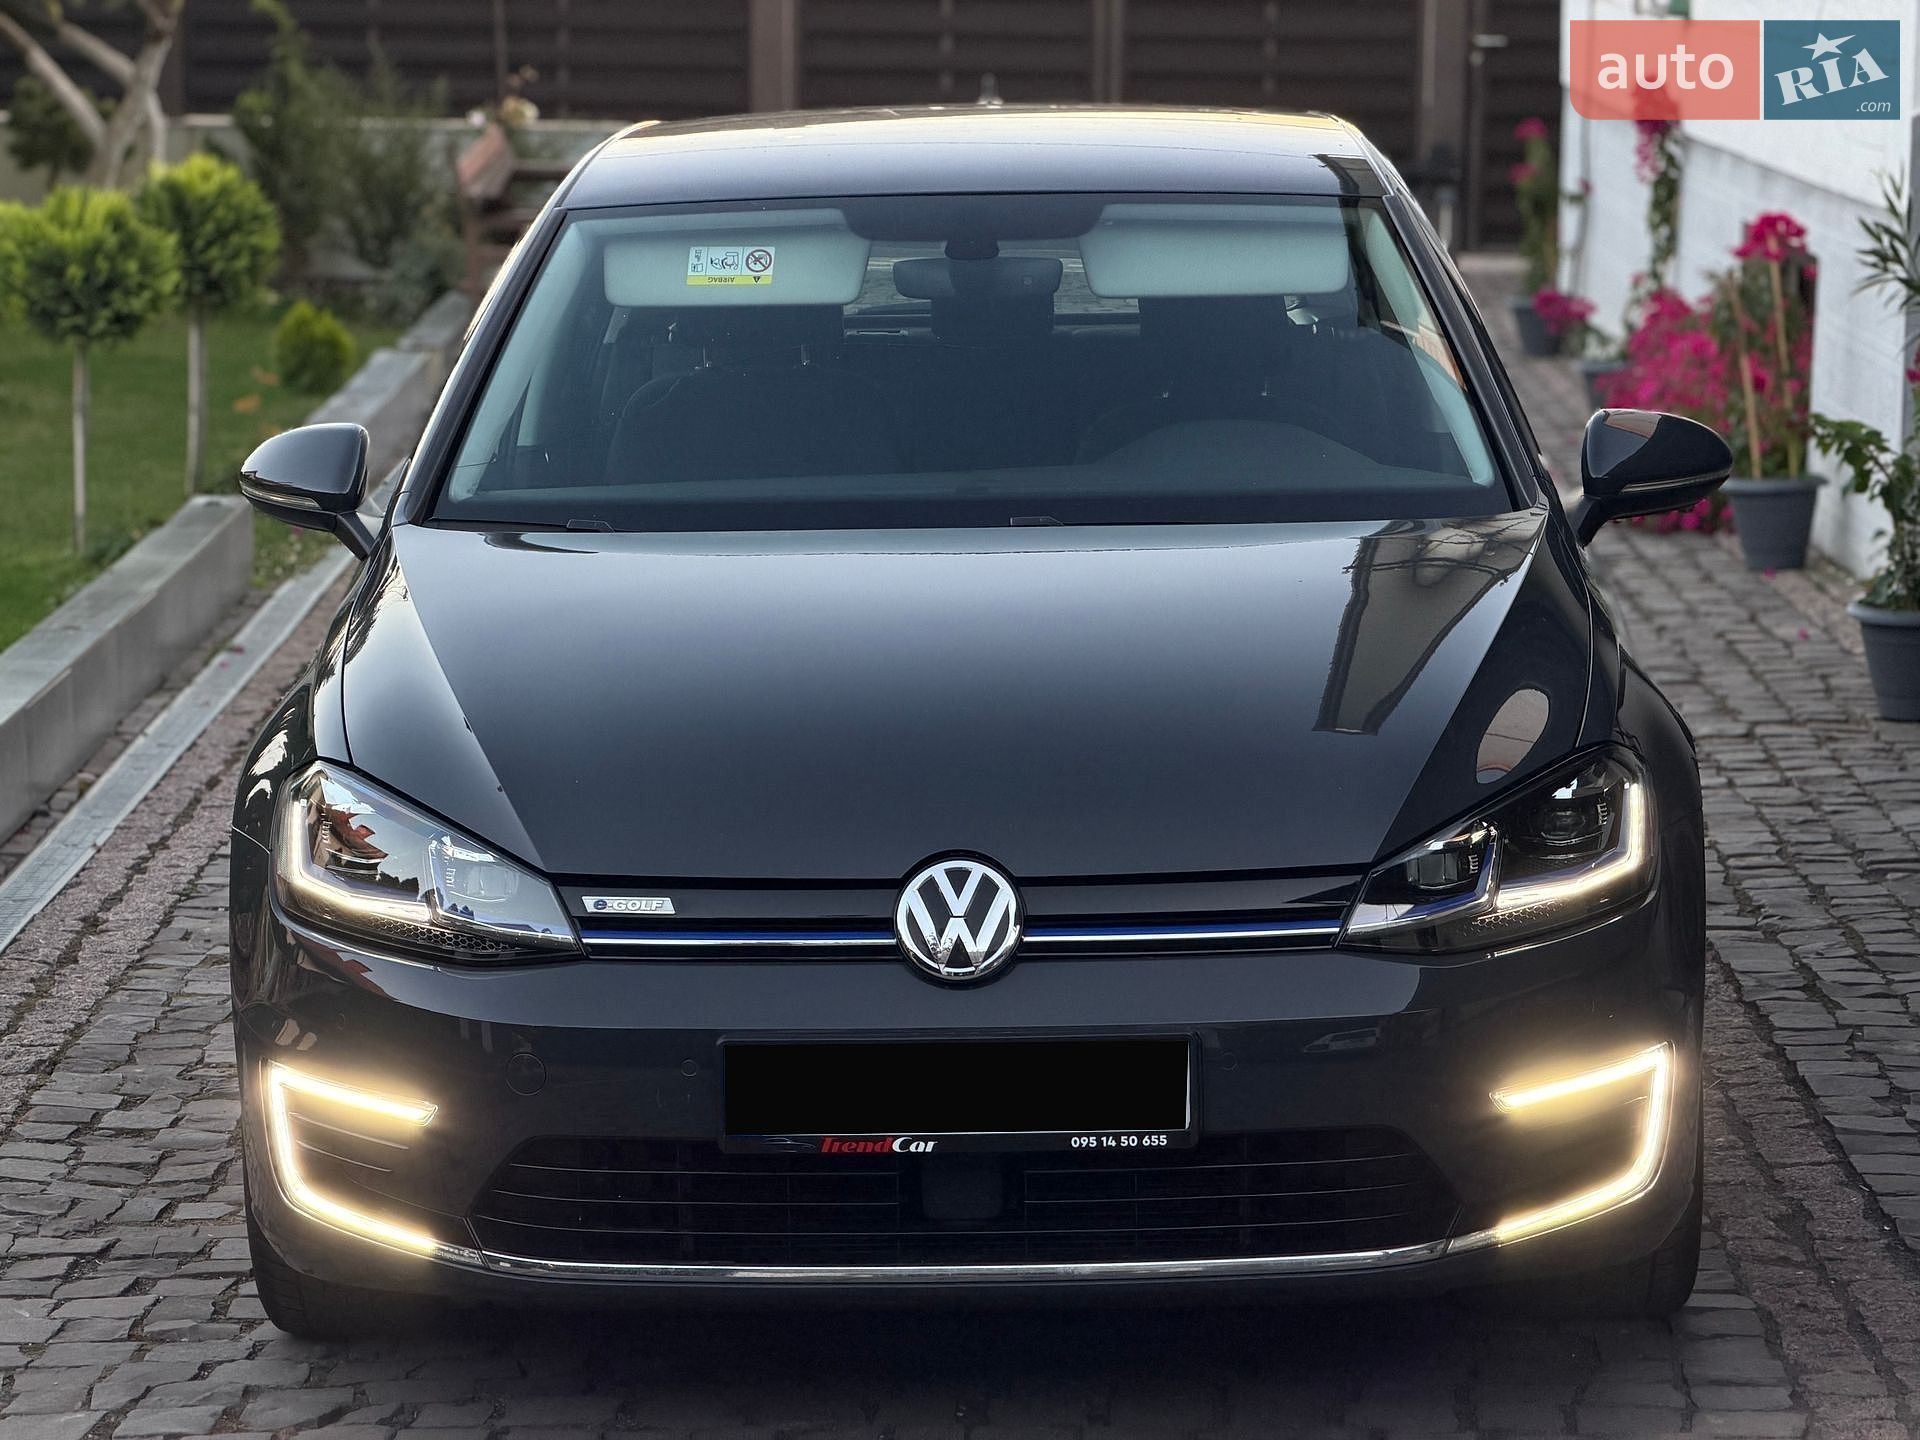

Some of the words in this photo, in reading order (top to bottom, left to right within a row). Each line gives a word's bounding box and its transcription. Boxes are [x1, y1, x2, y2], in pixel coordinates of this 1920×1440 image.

[1071, 1136, 1097, 1147] 095
[1100, 1136, 1117, 1147] 14
[1120, 1135, 1138, 1147] 50
[1142, 1135, 1168, 1147] 655
